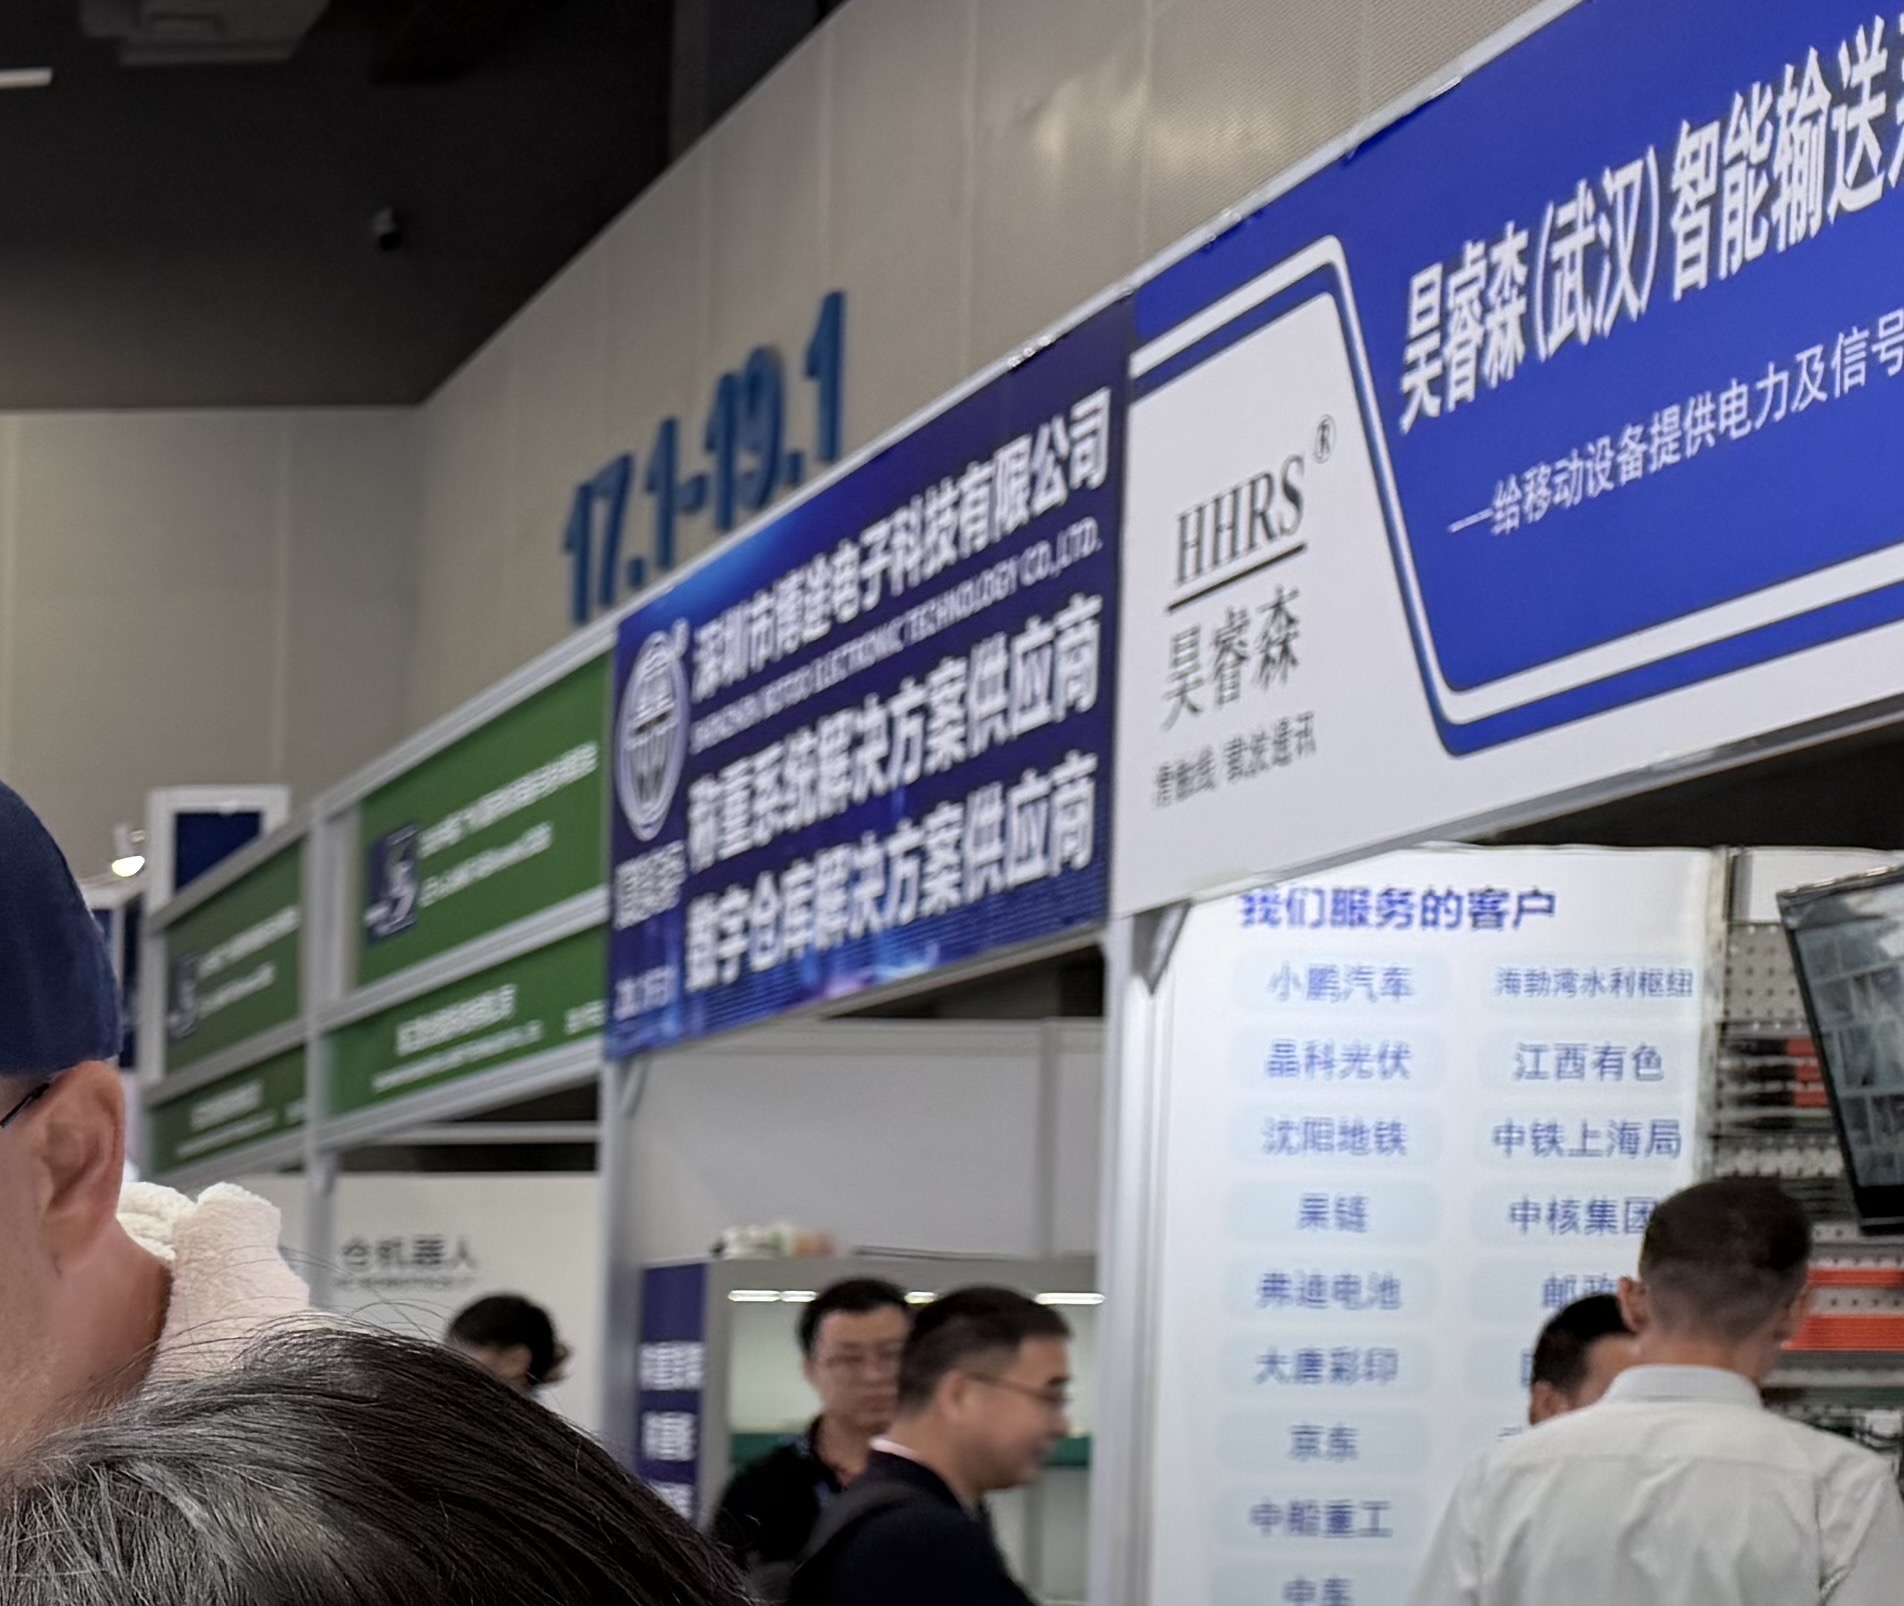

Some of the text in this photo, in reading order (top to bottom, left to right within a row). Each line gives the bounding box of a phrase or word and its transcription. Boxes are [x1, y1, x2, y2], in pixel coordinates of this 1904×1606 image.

[1174, 453, 1306, 587] HHRS
[1239, 886, 1558, 931] 我们服务的客户
[1266, 960, 1415, 1003] 小鹏汽车
[1267, 1038, 1412, 1080] 晶科光伏
[1514, 1041, 1665, 1083] 江西有色
[1262, 1116, 1408, 1157] 沈阳地铁
[1492, 1119, 1682, 1160] 中铁上海局
[1253, 1345, 1399, 1385] 大唐彩印
[1249, 1496, 1393, 1539] 中船重工
